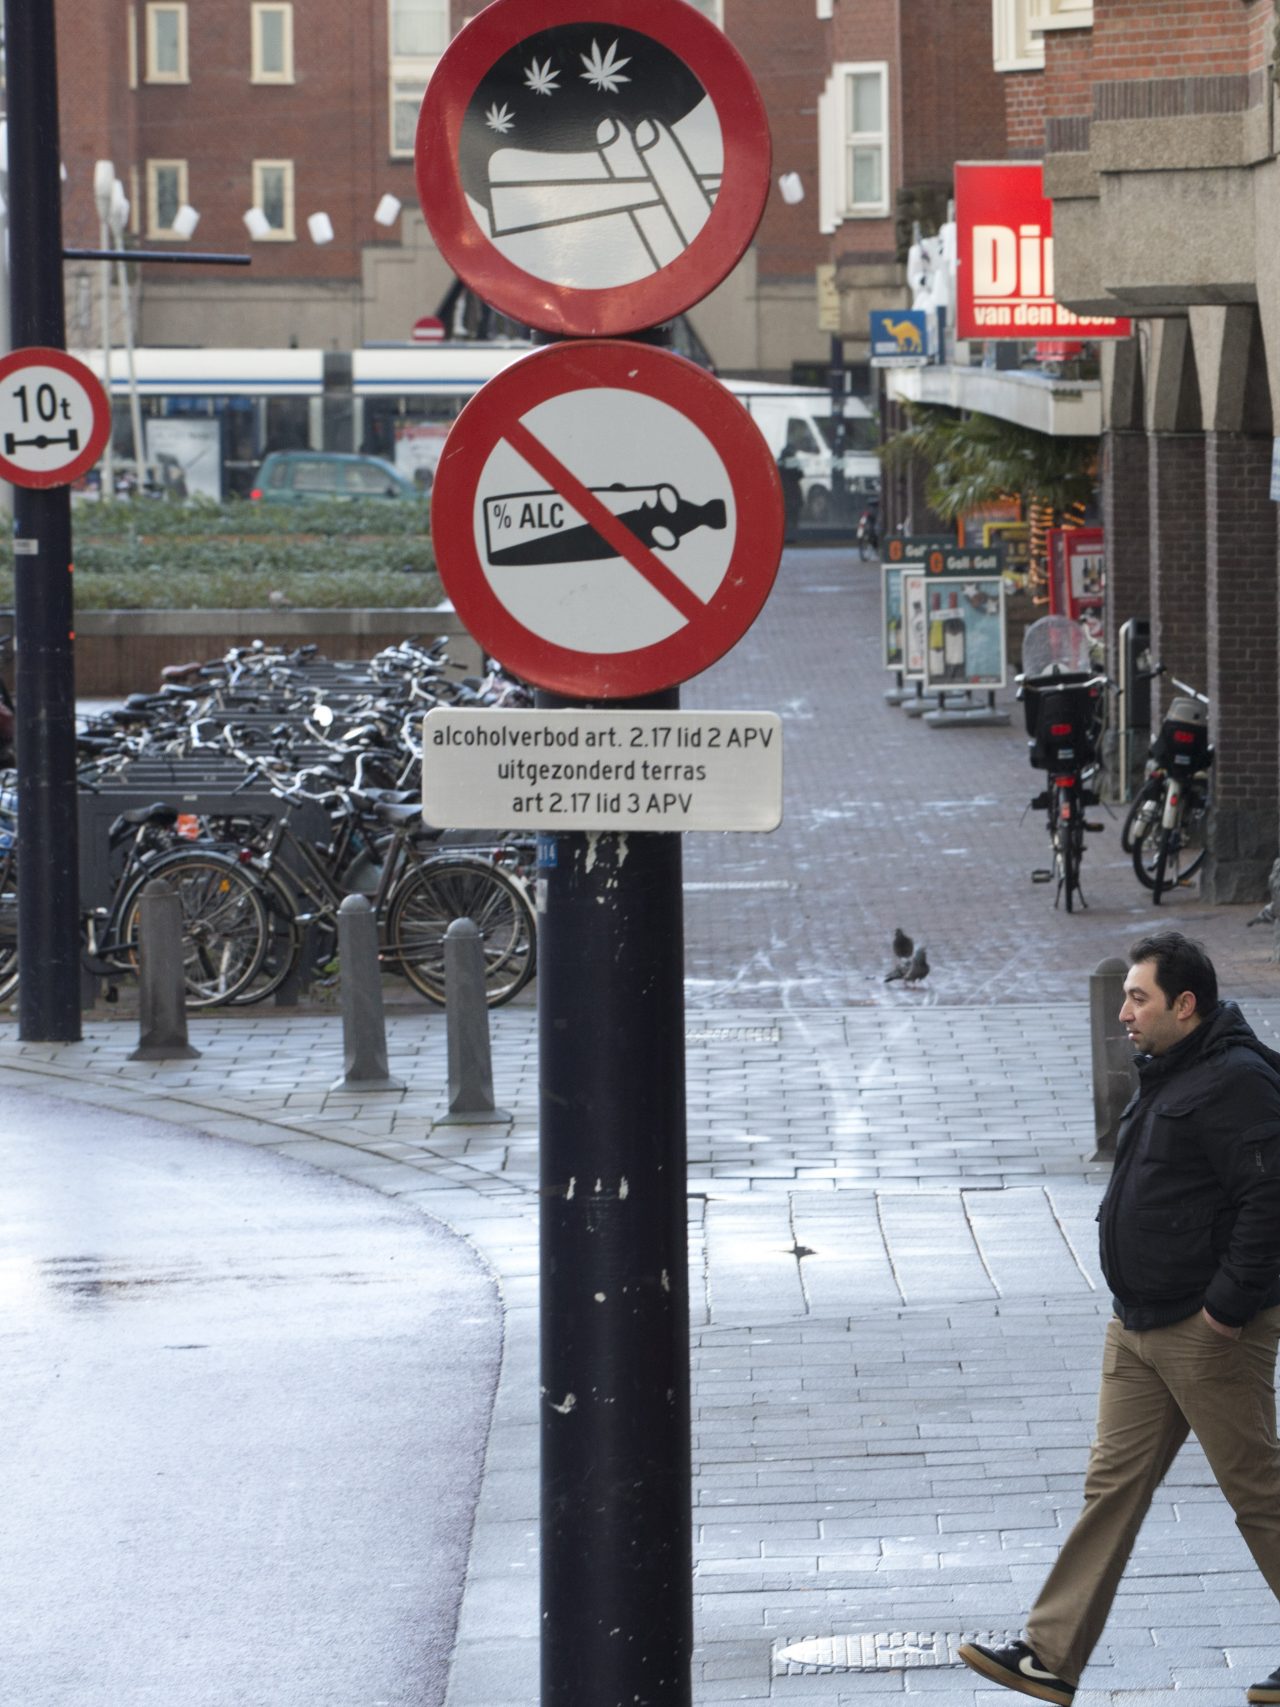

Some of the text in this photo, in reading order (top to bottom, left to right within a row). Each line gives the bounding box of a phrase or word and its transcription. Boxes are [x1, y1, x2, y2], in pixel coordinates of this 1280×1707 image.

[974, 306, 1011, 325] van
[1014, 303, 1053, 325] den
[493, 503, 564, 530] % ALC
[433, 725, 774, 748] alcoholverbod art. 2.17 lid 2 APV
[498, 760, 707, 786] uitgezonderd terras
[512, 793, 693, 813] art 2.17 lid 3 APV
